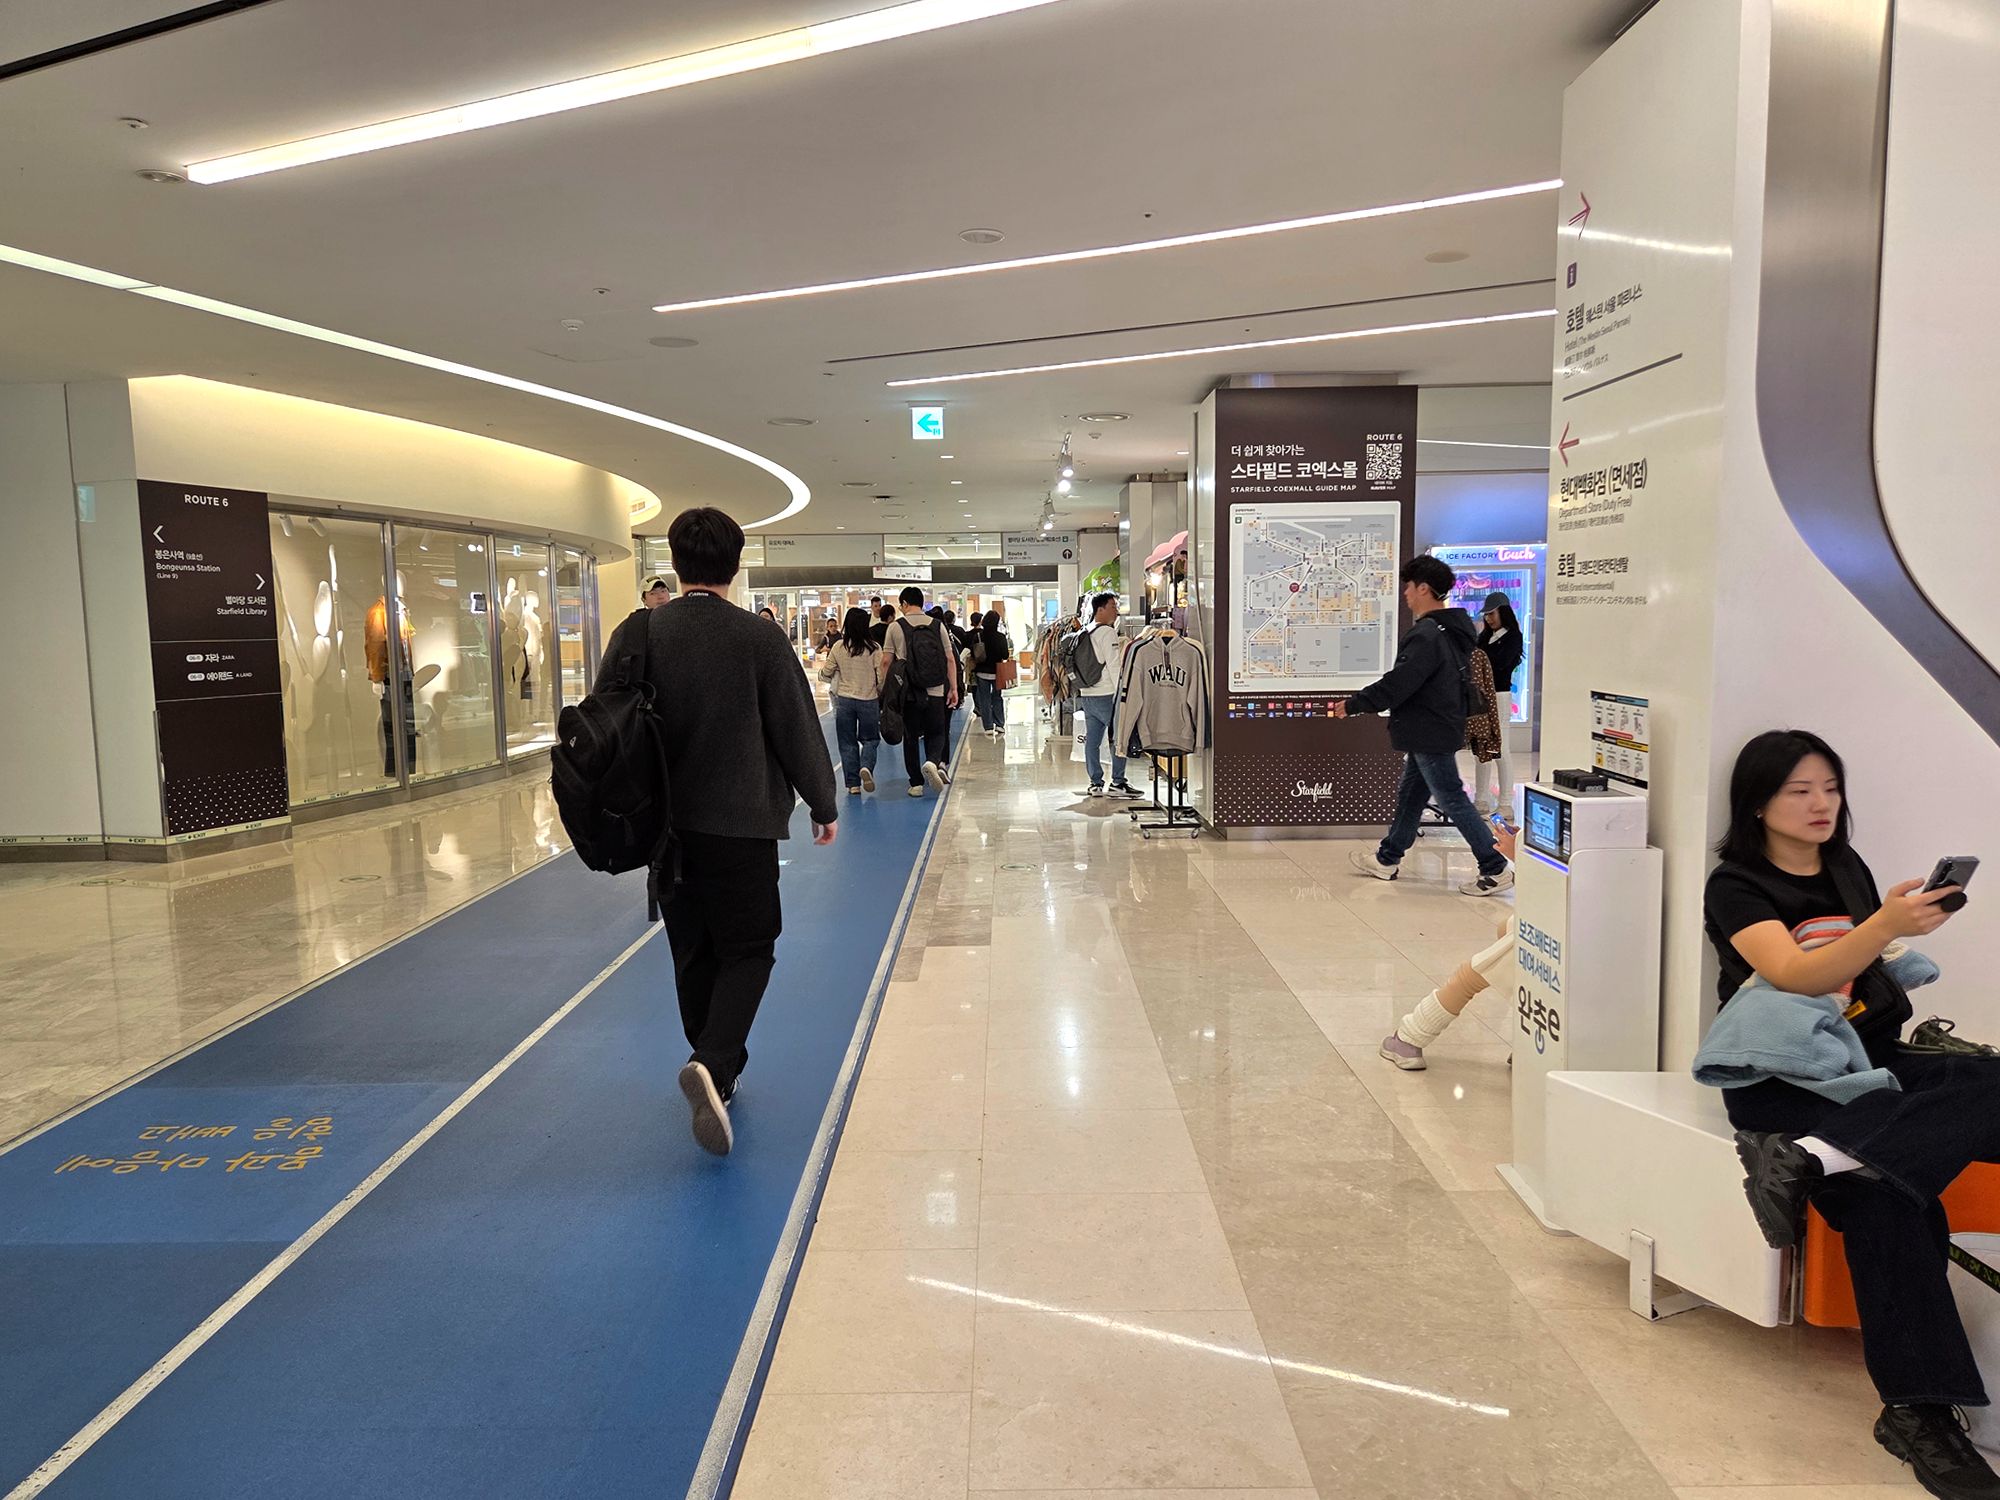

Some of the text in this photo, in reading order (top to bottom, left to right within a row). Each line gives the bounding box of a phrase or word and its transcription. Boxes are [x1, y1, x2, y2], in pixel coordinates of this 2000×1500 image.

[1565, 303, 1585, 335] 호텔
[1366, 433, 1403, 441] ROUTE 6
[1231, 444, 1305, 457] 더 쉽게 찾아가는
[1230, 460, 1359, 481] 스타필드 코엑스몰
[1560, 457, 1648, 503] 현대백화점 (면세점)
[1273, 485, 1313, 493] COEXMALL
[184, 494, 229, 507] ROUTE 6
[155, 549, 184, 560] 봉은사역
[1461, 552, 1498, 560] FACTORY
[156, 563, 221, 572] Bongeunsa Station
[1557, 552, 1576, 577] 호텔
[225, 595, 267, 605] 별마당 도서관
[216, 607, 268, 616] Starfield Library
[204, 653, 220, 663] 자라
[1148, 663, 1187, 687] WAU
[1290, 780, 1333, 803] Starfield
[1518, 918, 1561, 965] 보조배터리
[1518, 946, 1561, 994] 대여서비스
[138, 1116, 334, 1143] 힘을 빼고
[53, 1145, 325, 1175] 몸과 마음에
